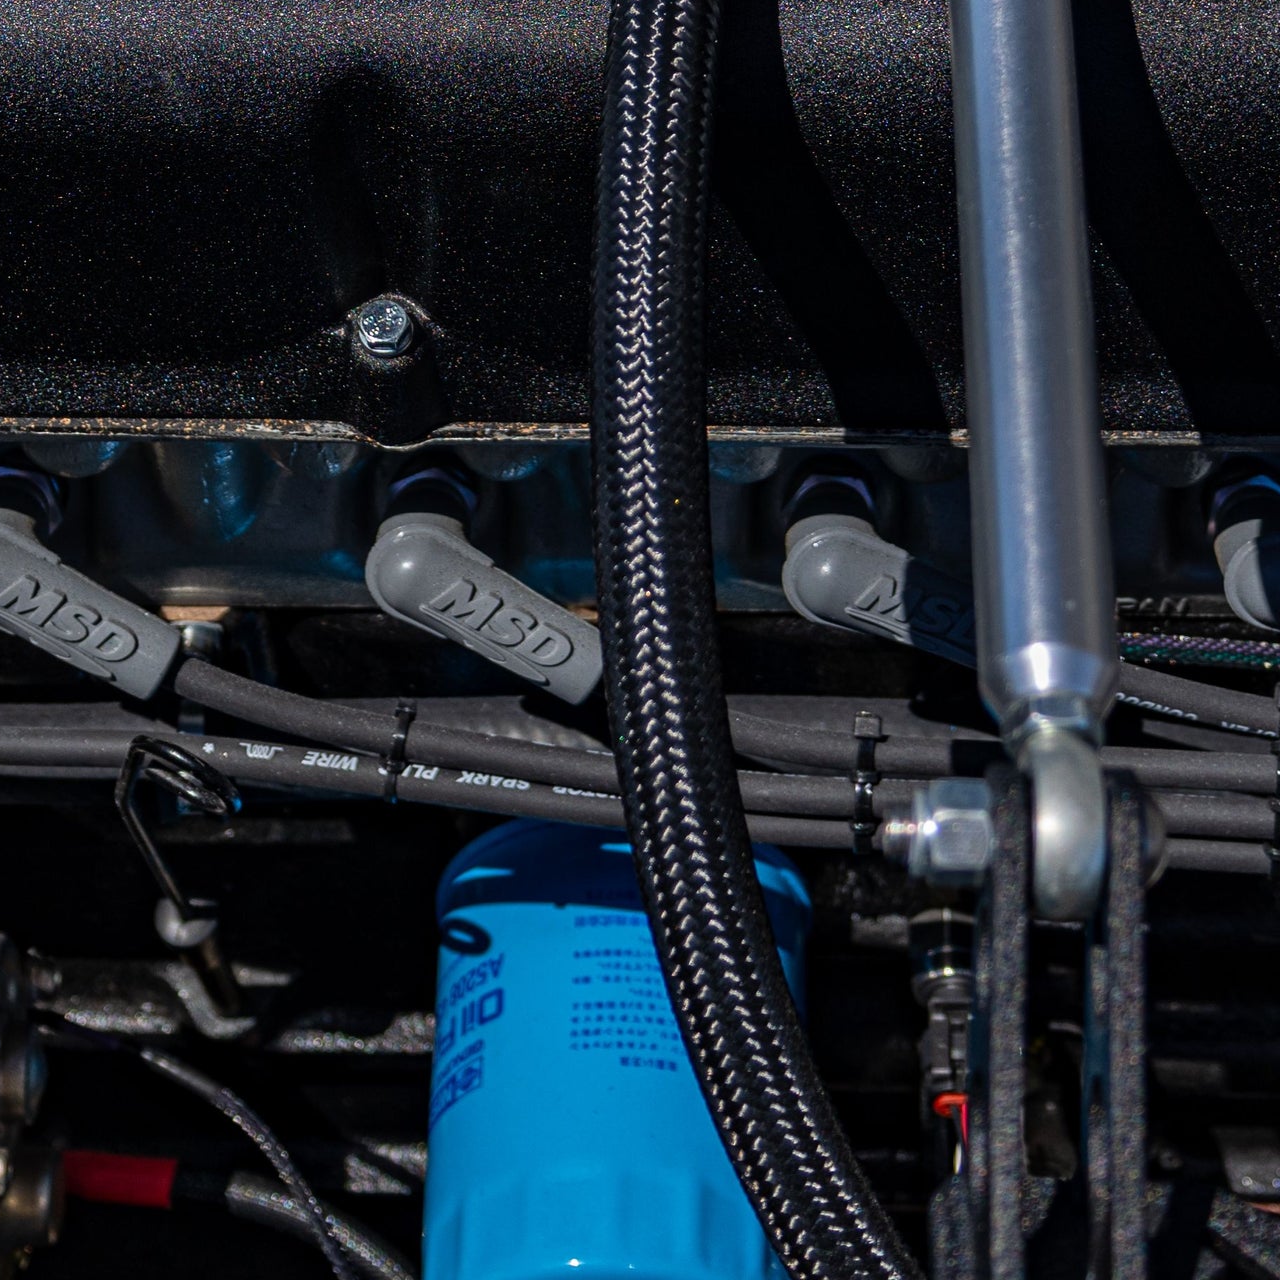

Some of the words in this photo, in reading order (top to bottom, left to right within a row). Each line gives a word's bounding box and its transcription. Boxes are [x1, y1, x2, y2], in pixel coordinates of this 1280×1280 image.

[427, 575, 578, 668] MSD
[301, 750, 359, 772] WIRE
[460, 988, 504, 1037] Oil
